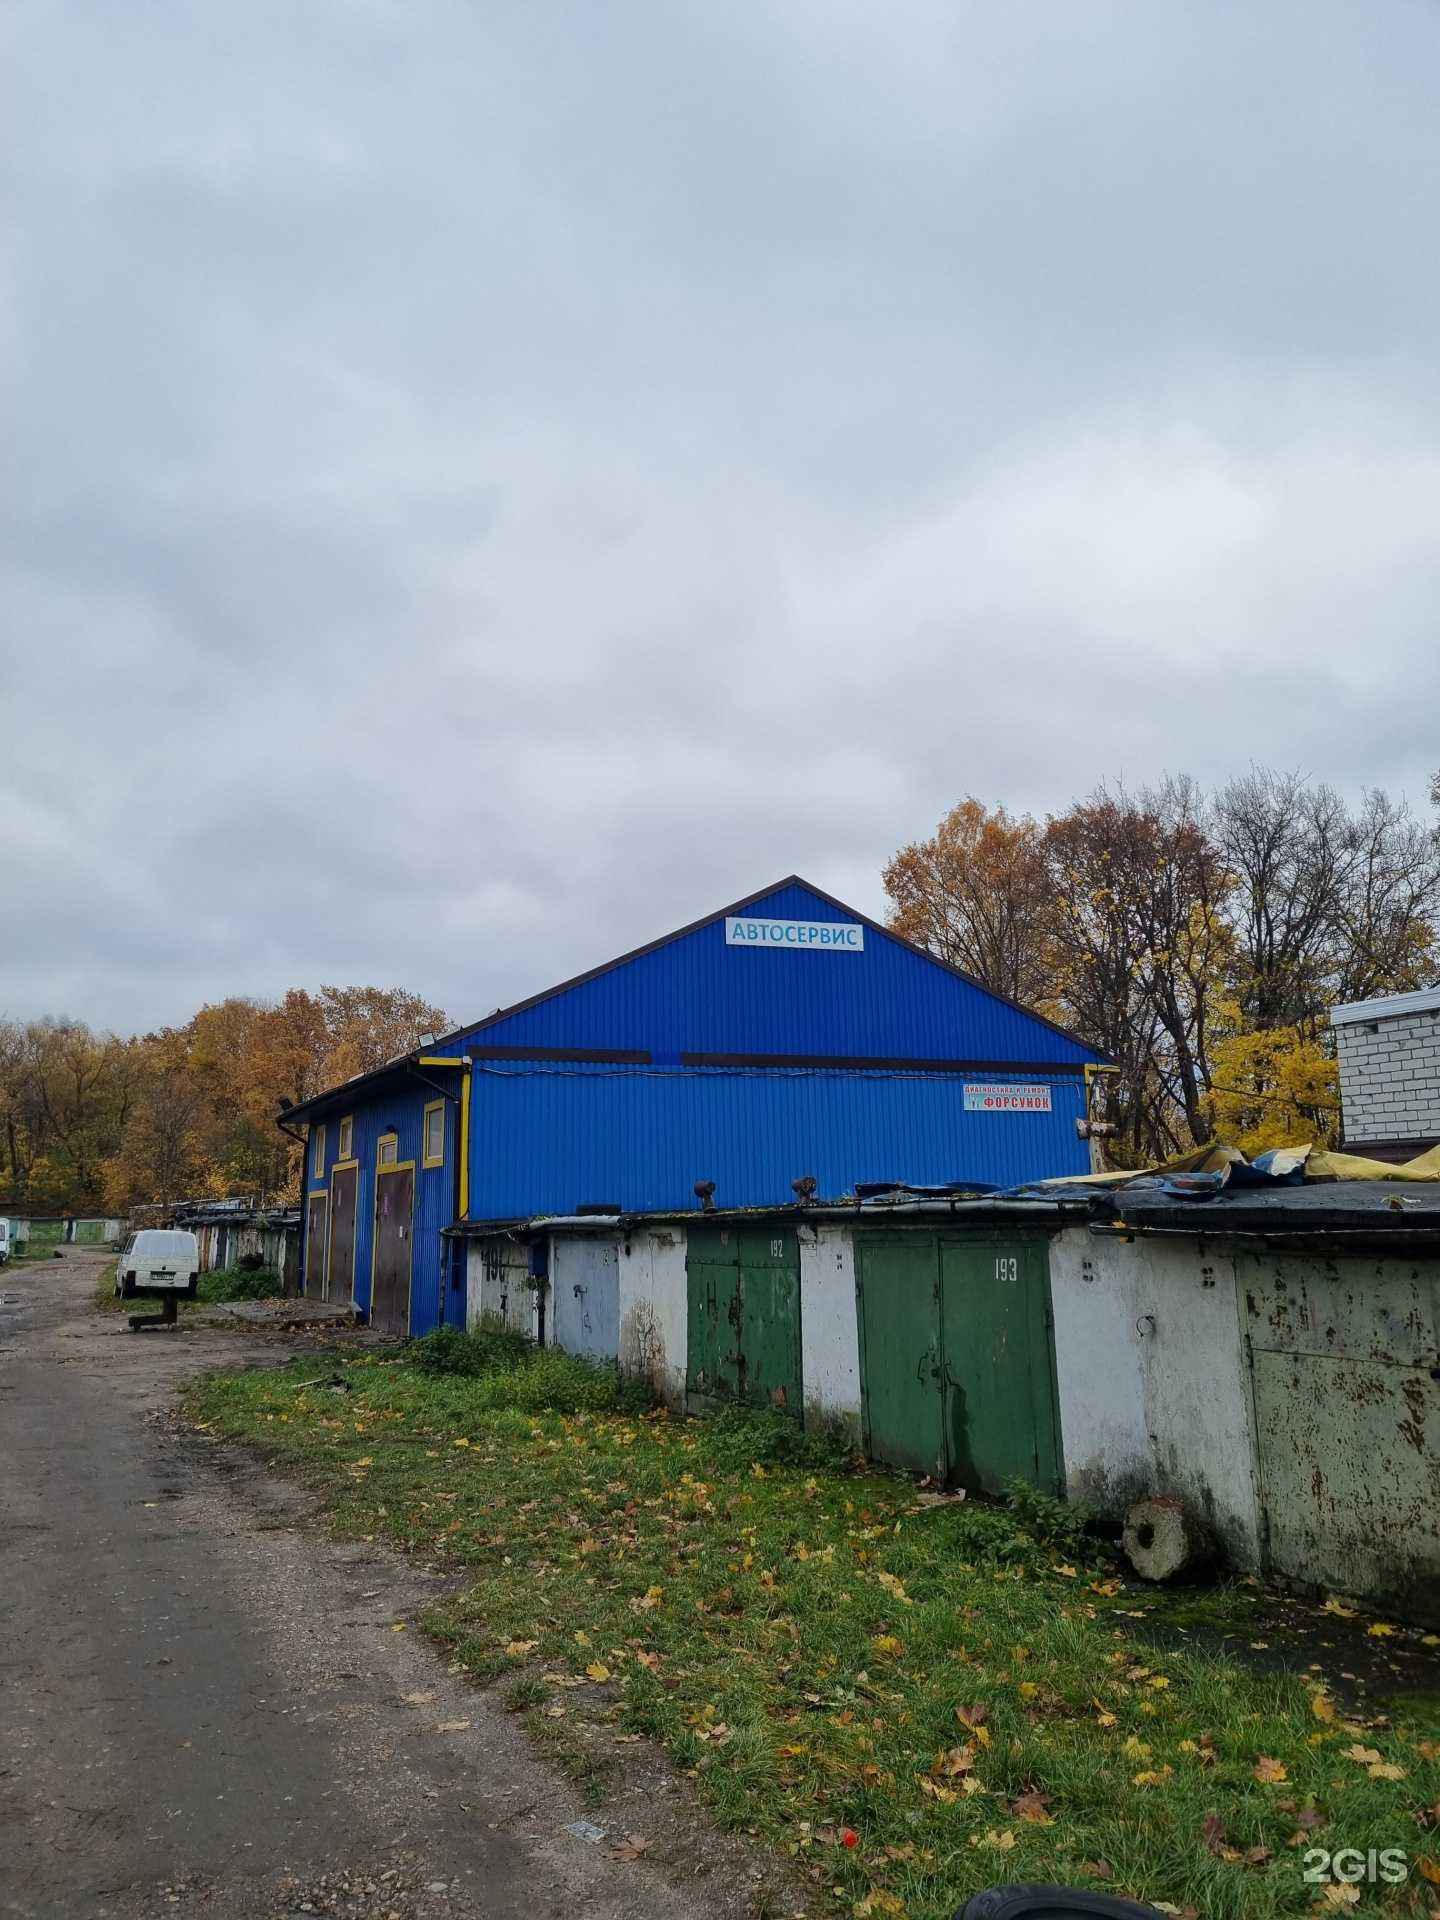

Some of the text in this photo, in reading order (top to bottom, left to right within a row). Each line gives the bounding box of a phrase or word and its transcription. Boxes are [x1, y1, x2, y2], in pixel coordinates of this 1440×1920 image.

[732, 922, 857, 946] АВТОСЕРВИС
[984, 1096, 1049, 1109] ФОРСУНОК
[771, 1239, 783, 1258] 192
[995, 1258, 1018, 1282] 193
